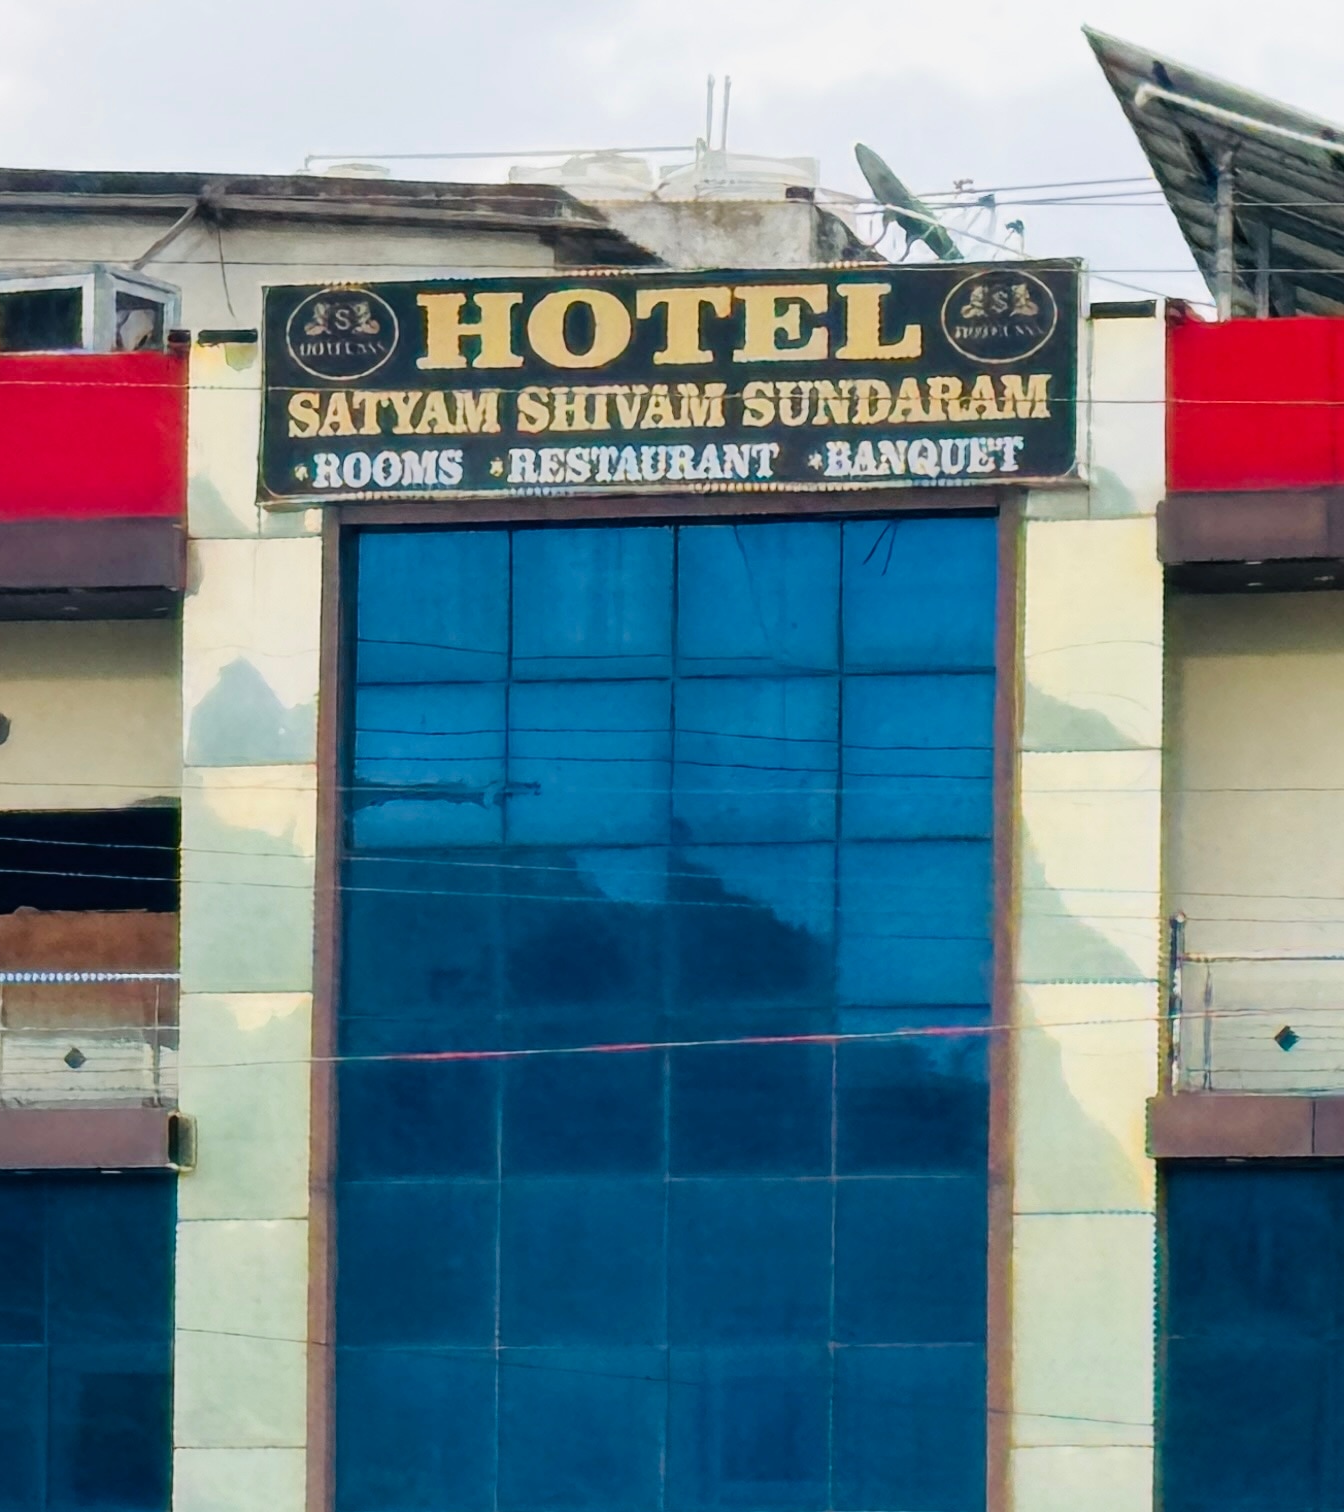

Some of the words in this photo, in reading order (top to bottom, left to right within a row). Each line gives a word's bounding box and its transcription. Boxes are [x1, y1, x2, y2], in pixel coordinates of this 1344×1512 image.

[334, 308, 352, 331] S
[416, 284, 922, 370] HOTEL
[288, 390, 501, 438] SATYAM
[518, 383, 725, 433] SHIVAM
[742, 375, 1052, 427] SUNDARAM
[312, 449, 464, 489] ROOMS
[508, 444, 780, 483] RESTAURANT
[824, 437, 1024, 477] BANQUET
